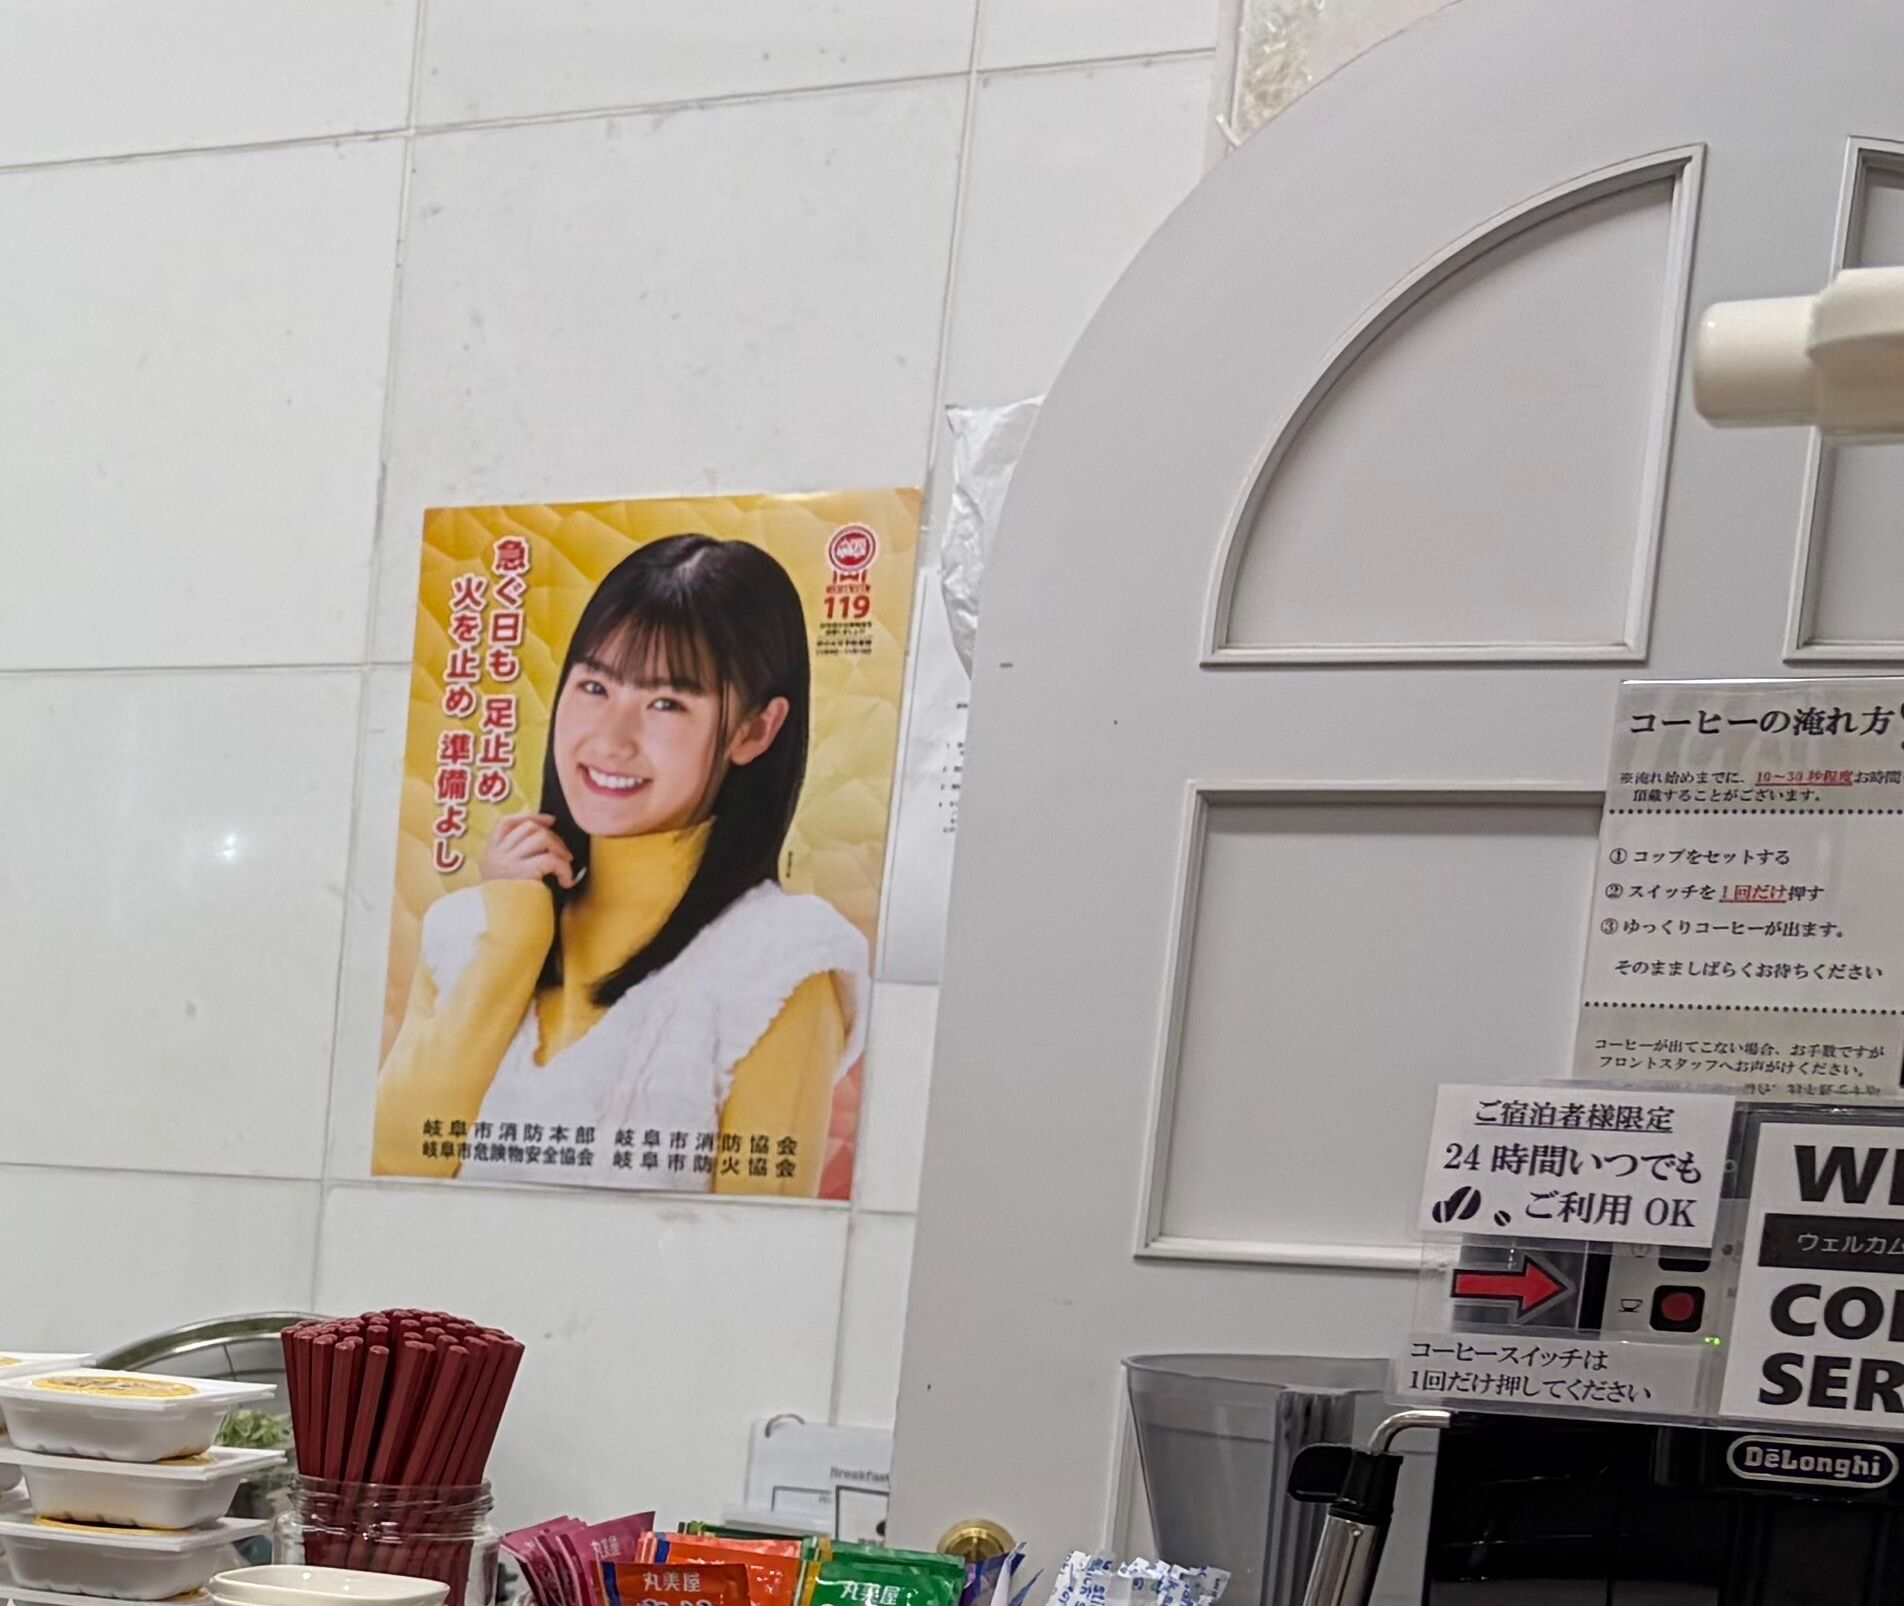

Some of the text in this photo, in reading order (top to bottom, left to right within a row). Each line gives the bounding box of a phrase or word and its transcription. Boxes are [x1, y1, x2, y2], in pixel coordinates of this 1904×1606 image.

[824, 595, 871, 619] 119
[476, 537, 529, 801] 急ぐ日も 足止め
[433, 574, 486, 873] 火を止め 準備よし
[1630, 706, 1895, 737] コーヒーの淹れ方
[1633, 848, 1791, 867] コップをセットする
[1623, 918, 1845, 939] ゆっくりコーヒーが出ます。
[1614, 959, 1884, 981] そのまましばらくお待ちください
[1594, 1037, 1886, 1060] コーヒーが出てこない場合、お手数ですが
[1474, 1098, 1675, 1132] ご宿泊者様限定
[423, 1118, 799, 1157] 岐阜市消防本部 岐阜市消防協会
[422, 1141, 797, 1178] 岐阜市危険物安全協会 岐阜市防火協会
[1410, 1341, 1609, 1372] コーヒースイッチは
[1409, 1369, 1652, 1404] 1回だけ押してください
[643, 1571, 703, 1593] 丸美屋
[840, 1582, 900, 1606] 丸美屋
